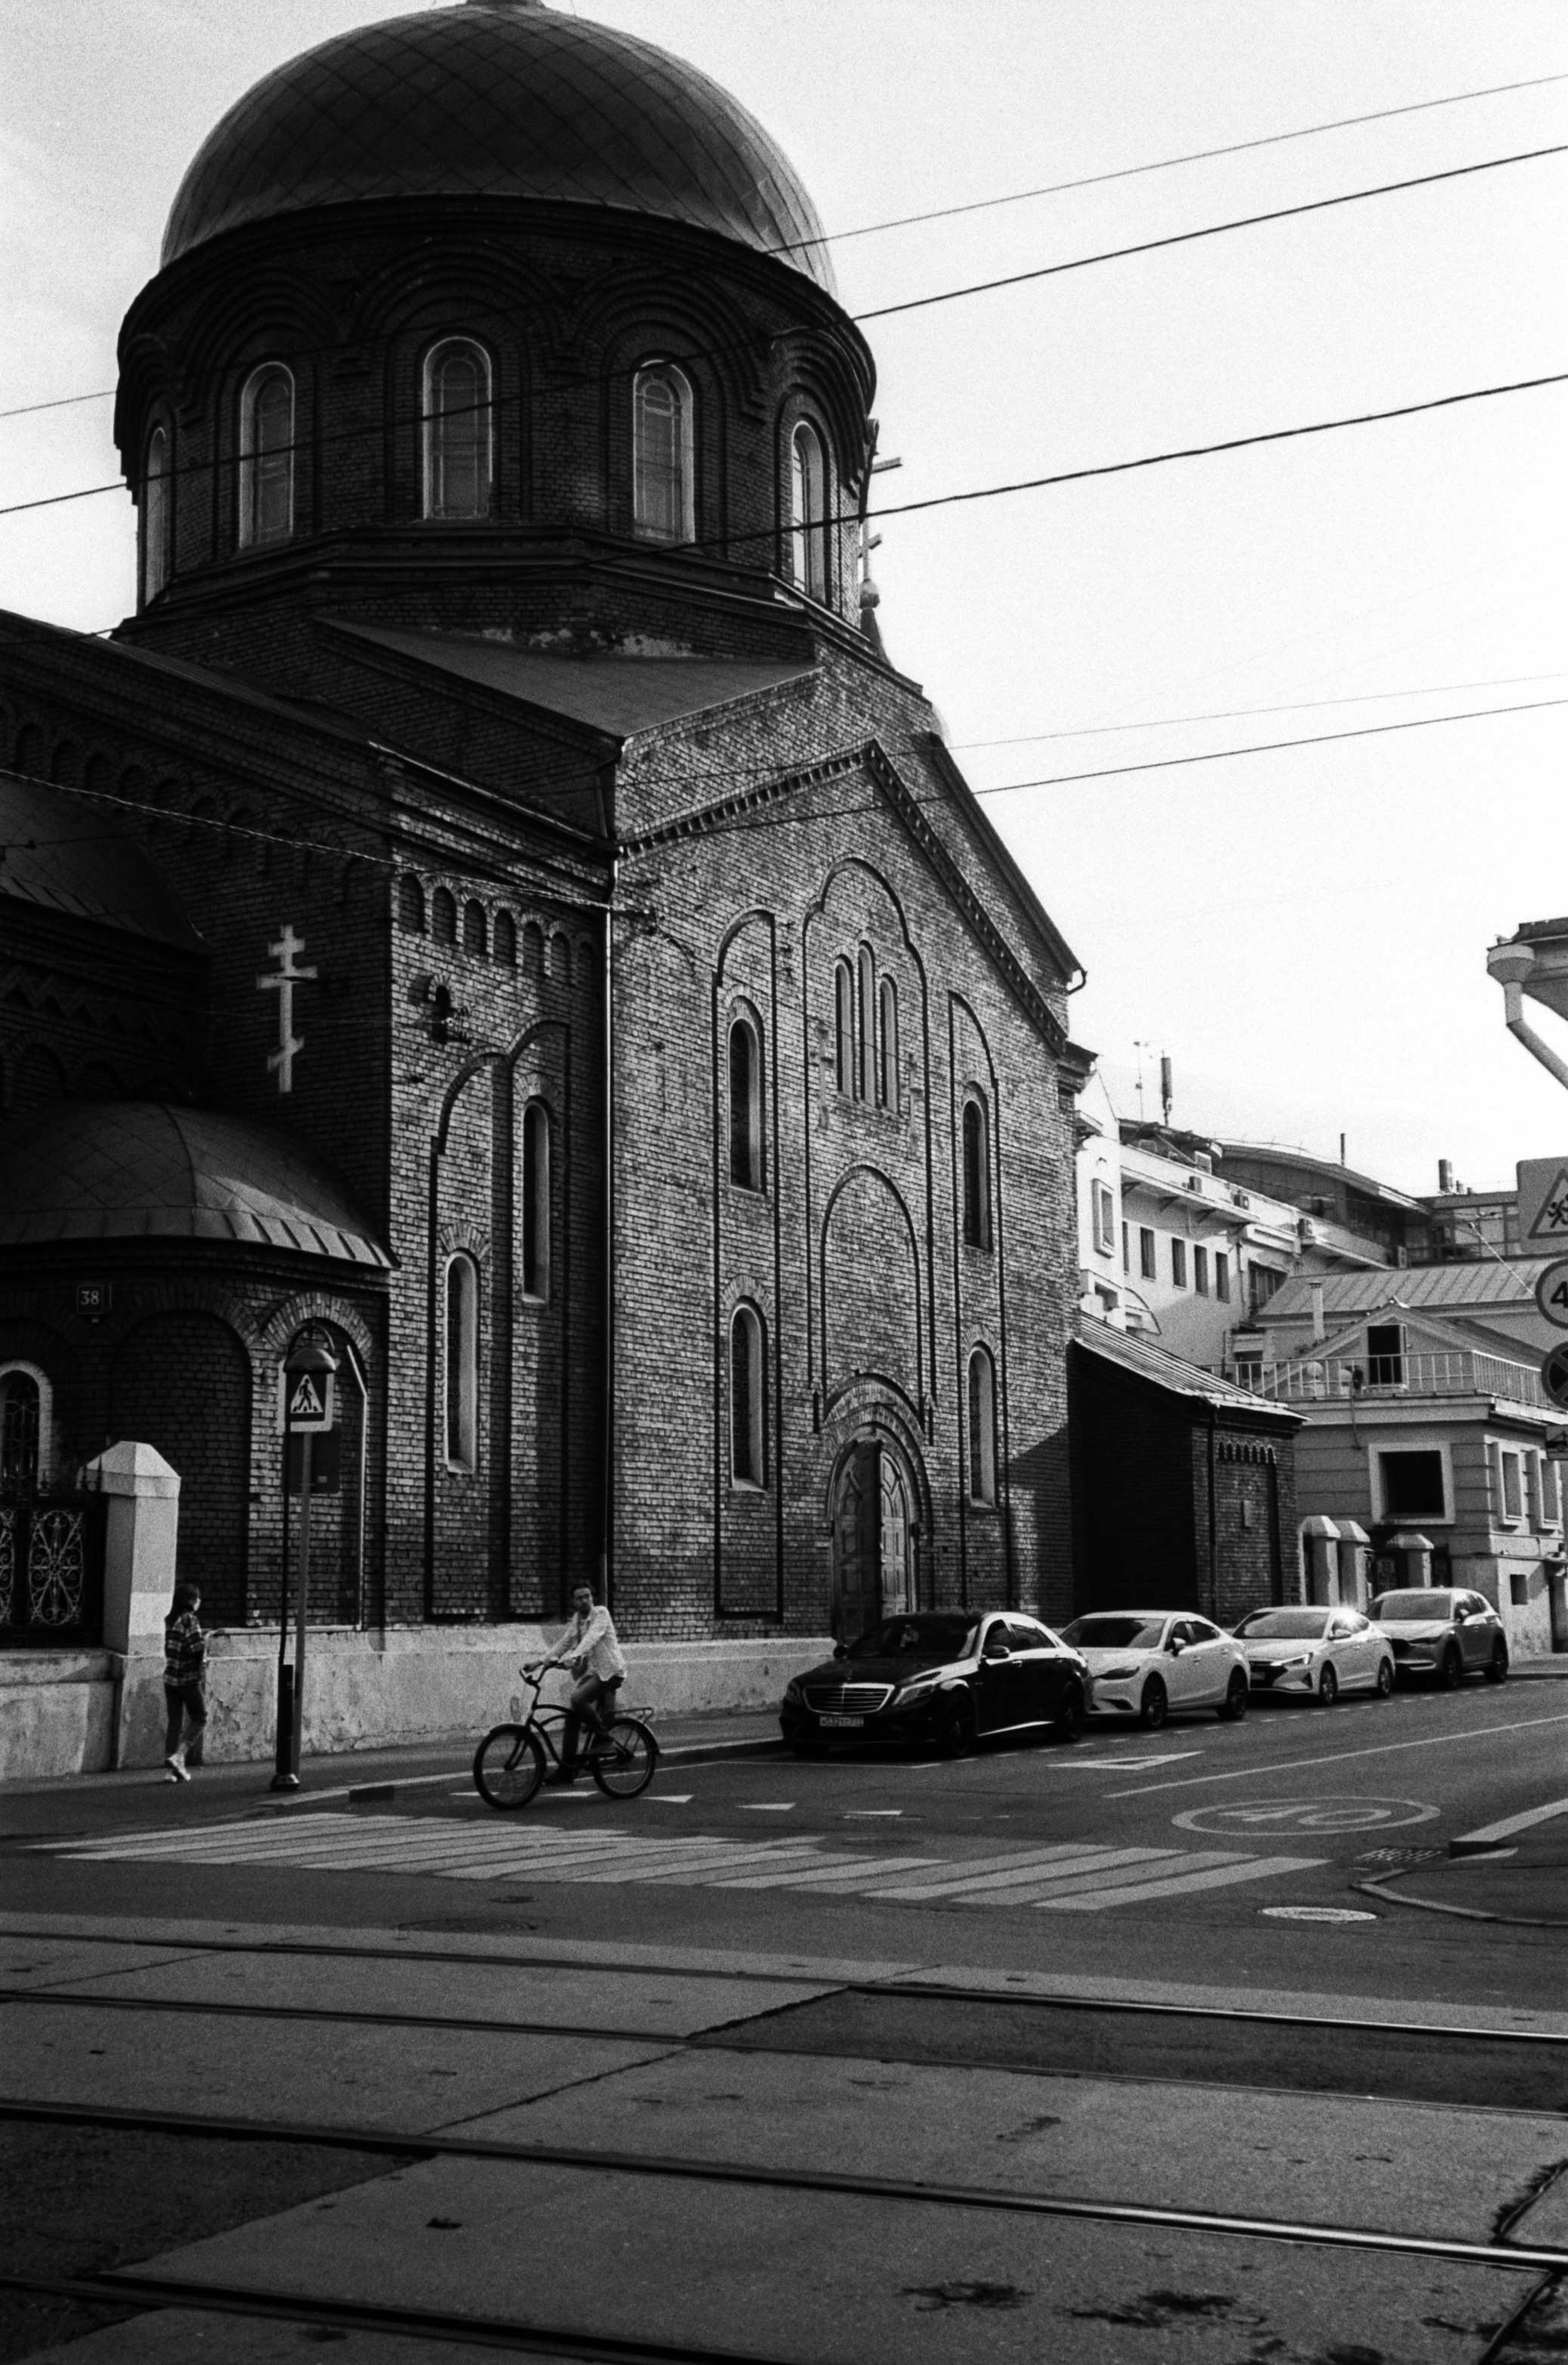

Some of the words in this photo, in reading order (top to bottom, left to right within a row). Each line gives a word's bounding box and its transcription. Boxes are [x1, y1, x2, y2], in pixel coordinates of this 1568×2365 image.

[81, 1291, 99, 1305] 38
[1550, 1281, 1568, 1308] 4
[1217, 1805, 1392, 1826] 40
